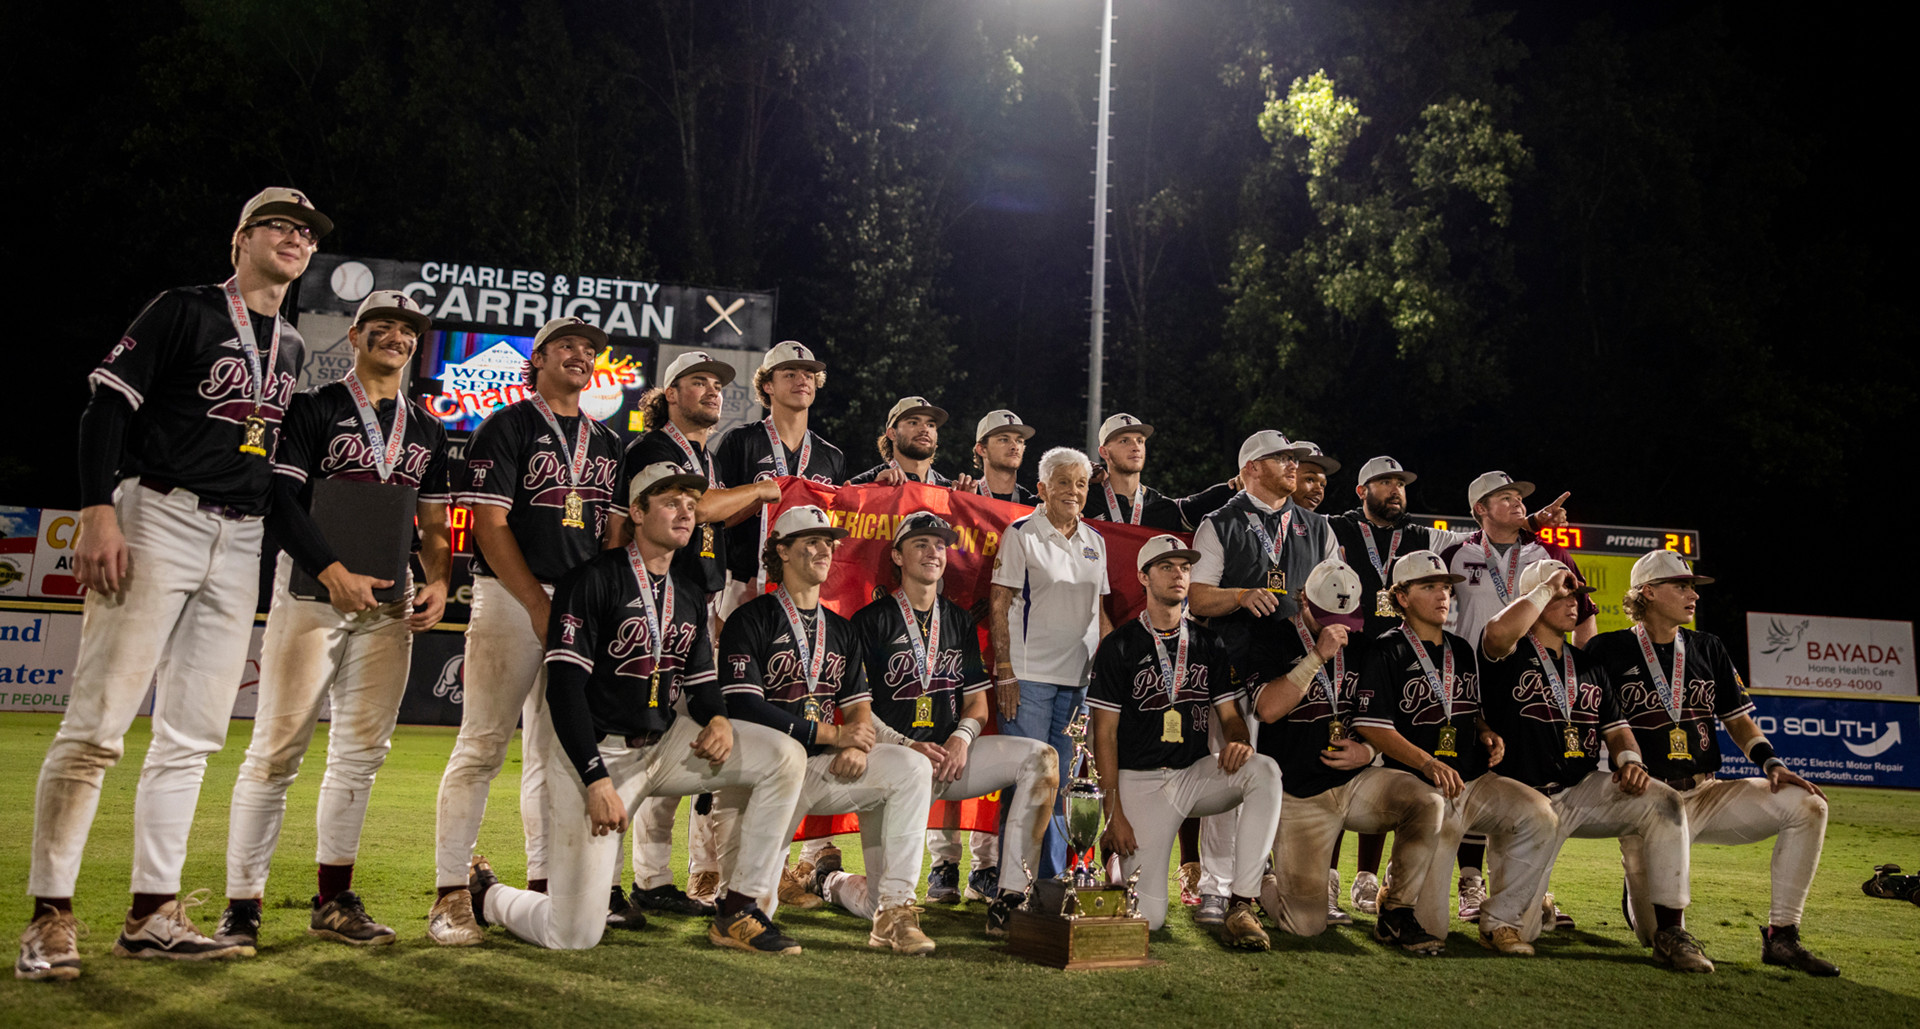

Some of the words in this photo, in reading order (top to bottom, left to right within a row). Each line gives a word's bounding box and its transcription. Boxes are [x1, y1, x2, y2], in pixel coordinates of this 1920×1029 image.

[420, 261, 546, 292] CHARLES
[551, 274, 570, 296] &
[576, 276, 660, 303] BETTY
[392, 295, 409, 310] T
[400, 281, 675, 339] CARRIGAN
[792, 346, 805, 359] T
[452, 367, 523, 380] WORL
[350, 382, 368, 409] SERIES
[1003, 414, 1016, 425] T
[1121, 416, 1133, 425] T
[366, 422, 383, 464] LEGION
[385, 434, 401, 465] WORLD
[672, 431, 693, 456] SERIES
[573, 444, 586, 474] WORLD
[1385, 459, 1397, 469] T
[472, 468, 488, 479] 70
[811, 509, 824, 523] T
[1166, 538, 1179, 551] T
[1605, 535, 1660, 549] PITCHES
[1665, 533, 1692, 554] 21
[632, 558, 649, 589] SERIES
[1427, 556, 1441, 570] T
[1470, 569, 1483, 579] 70
[1489, 567, 1506, 598] LEGION
[1506, 570, 1516, 595] WORLD
[783, 597, 800, 625] SERIES
[900, 598, 914, 626] SERIES
[1337, 594, 1350, 609] T
[562, 623, 576, 636] 70
[816, 619, 824, 649] SERIES
[912, 637, 924, 676] LEGION
[1178, 639, 1187, 665] SERIES
[1409, 636, 1426, 659] SERIES
[1641, 636, 1655, 664] SERIES
[1807, 642, 1901, 665] BAYADA
[732, 661, 747, 672] 70
[811, 648, 822, 678] WORLD
[926, 648, 936, 676] WORLD
[1675, 651, 1684, 679] SERIES
[1808, 664, 1836, 673] Home
[1839, 665, 1870, 676] Health
[1872, 667, 1895, 677] Care
[1160, 658, 1173, 694] LEGION
[1174, 664, 1185, 696] WORLD
[1785, 676, 1883, 691] 704-669-4000
[1359, 697, 1370, 706] 70
[1547, 672, 1566, 710] LEGION
[1568, 679, 1577, 708] WORLD
[1579, 681, 1603, 712] 70
[1653, 675, 1673, 712] LEGION
[1673, 679, 1683, 710] WORLD
[1696, 721, 1711, 751] 3
[1783, 718, 1877, 740] SOUTH
[1584, 728, 1599, 758] 4
[1809, 758, 1845, 769] Electric
[1846, 761, 1873, 771] Motor
[1874, 763, 1904, 773] Repair
